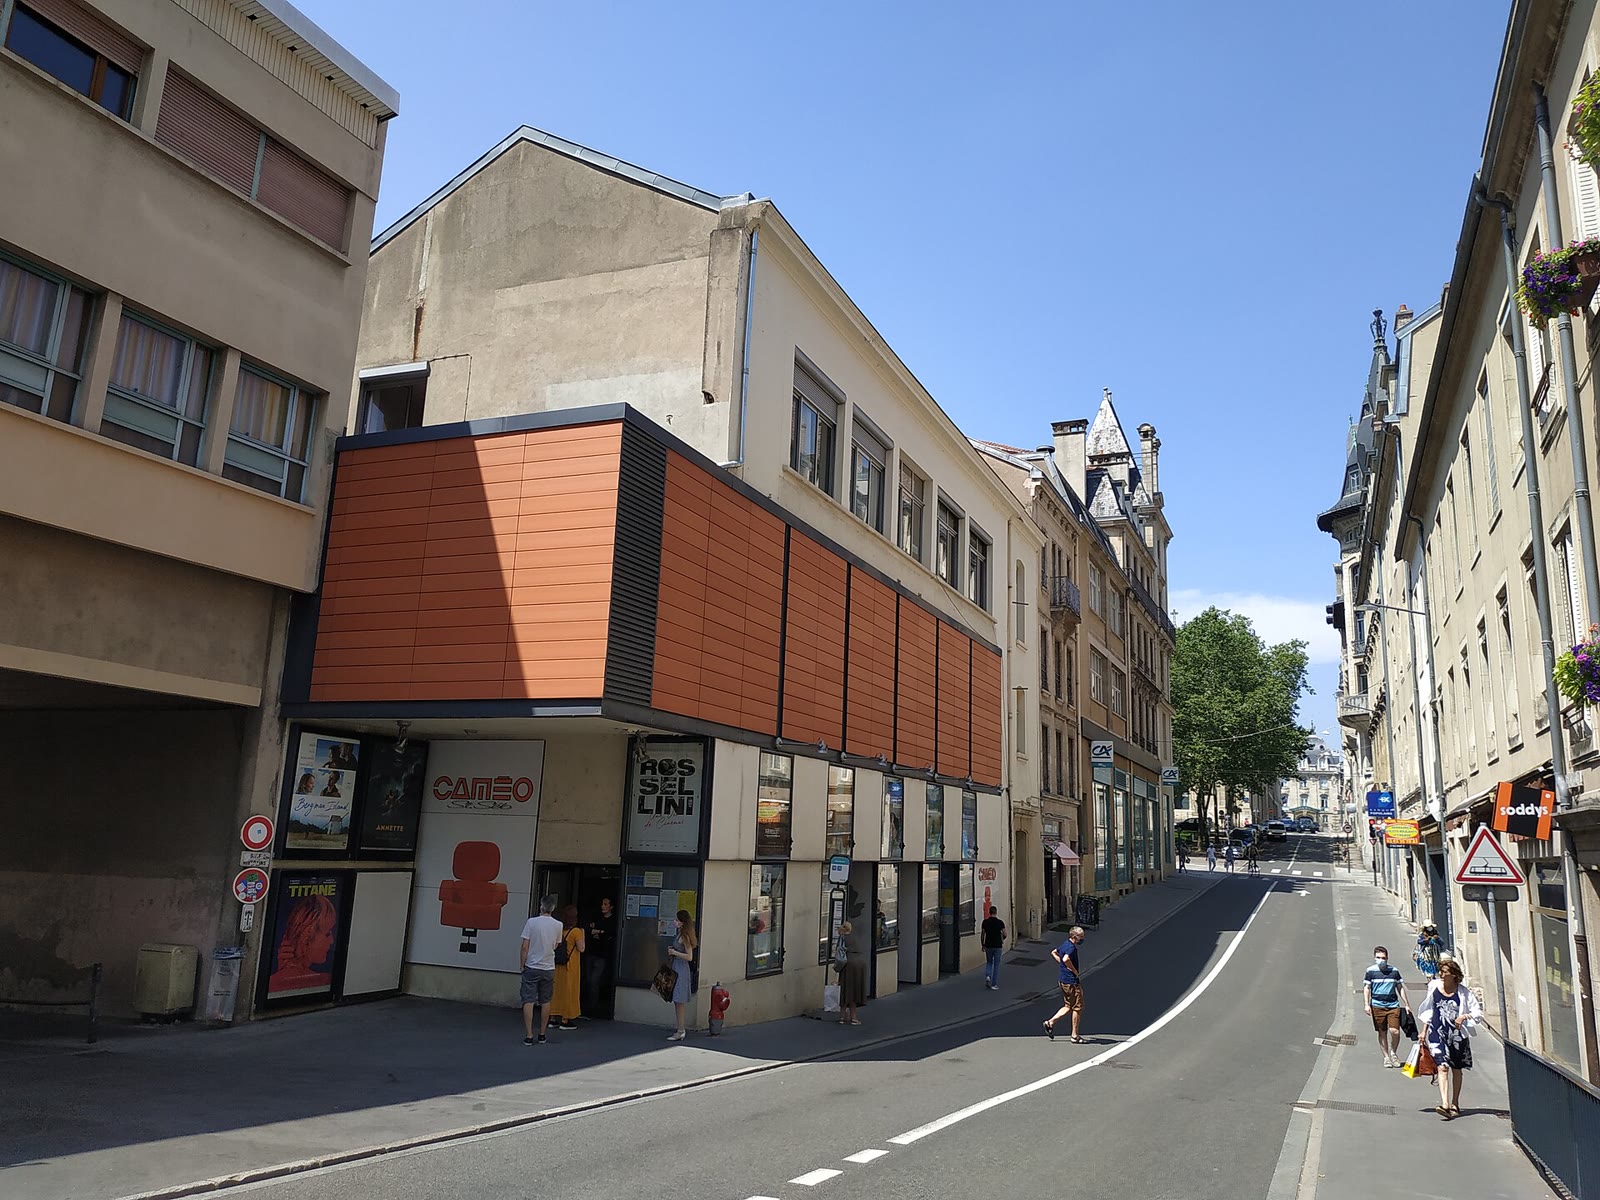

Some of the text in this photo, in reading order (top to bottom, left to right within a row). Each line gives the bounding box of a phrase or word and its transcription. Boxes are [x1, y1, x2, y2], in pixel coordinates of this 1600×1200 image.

[639, 758, 696, 777] ROS
[639, 776, 694, 795] SEL
[637, 795, 693, 815] LINI
[1499, 803, 1549, 818] soddys
[376, 824, 404, 832] ANNETTE
[288, 884, 337, 898] TITANE
